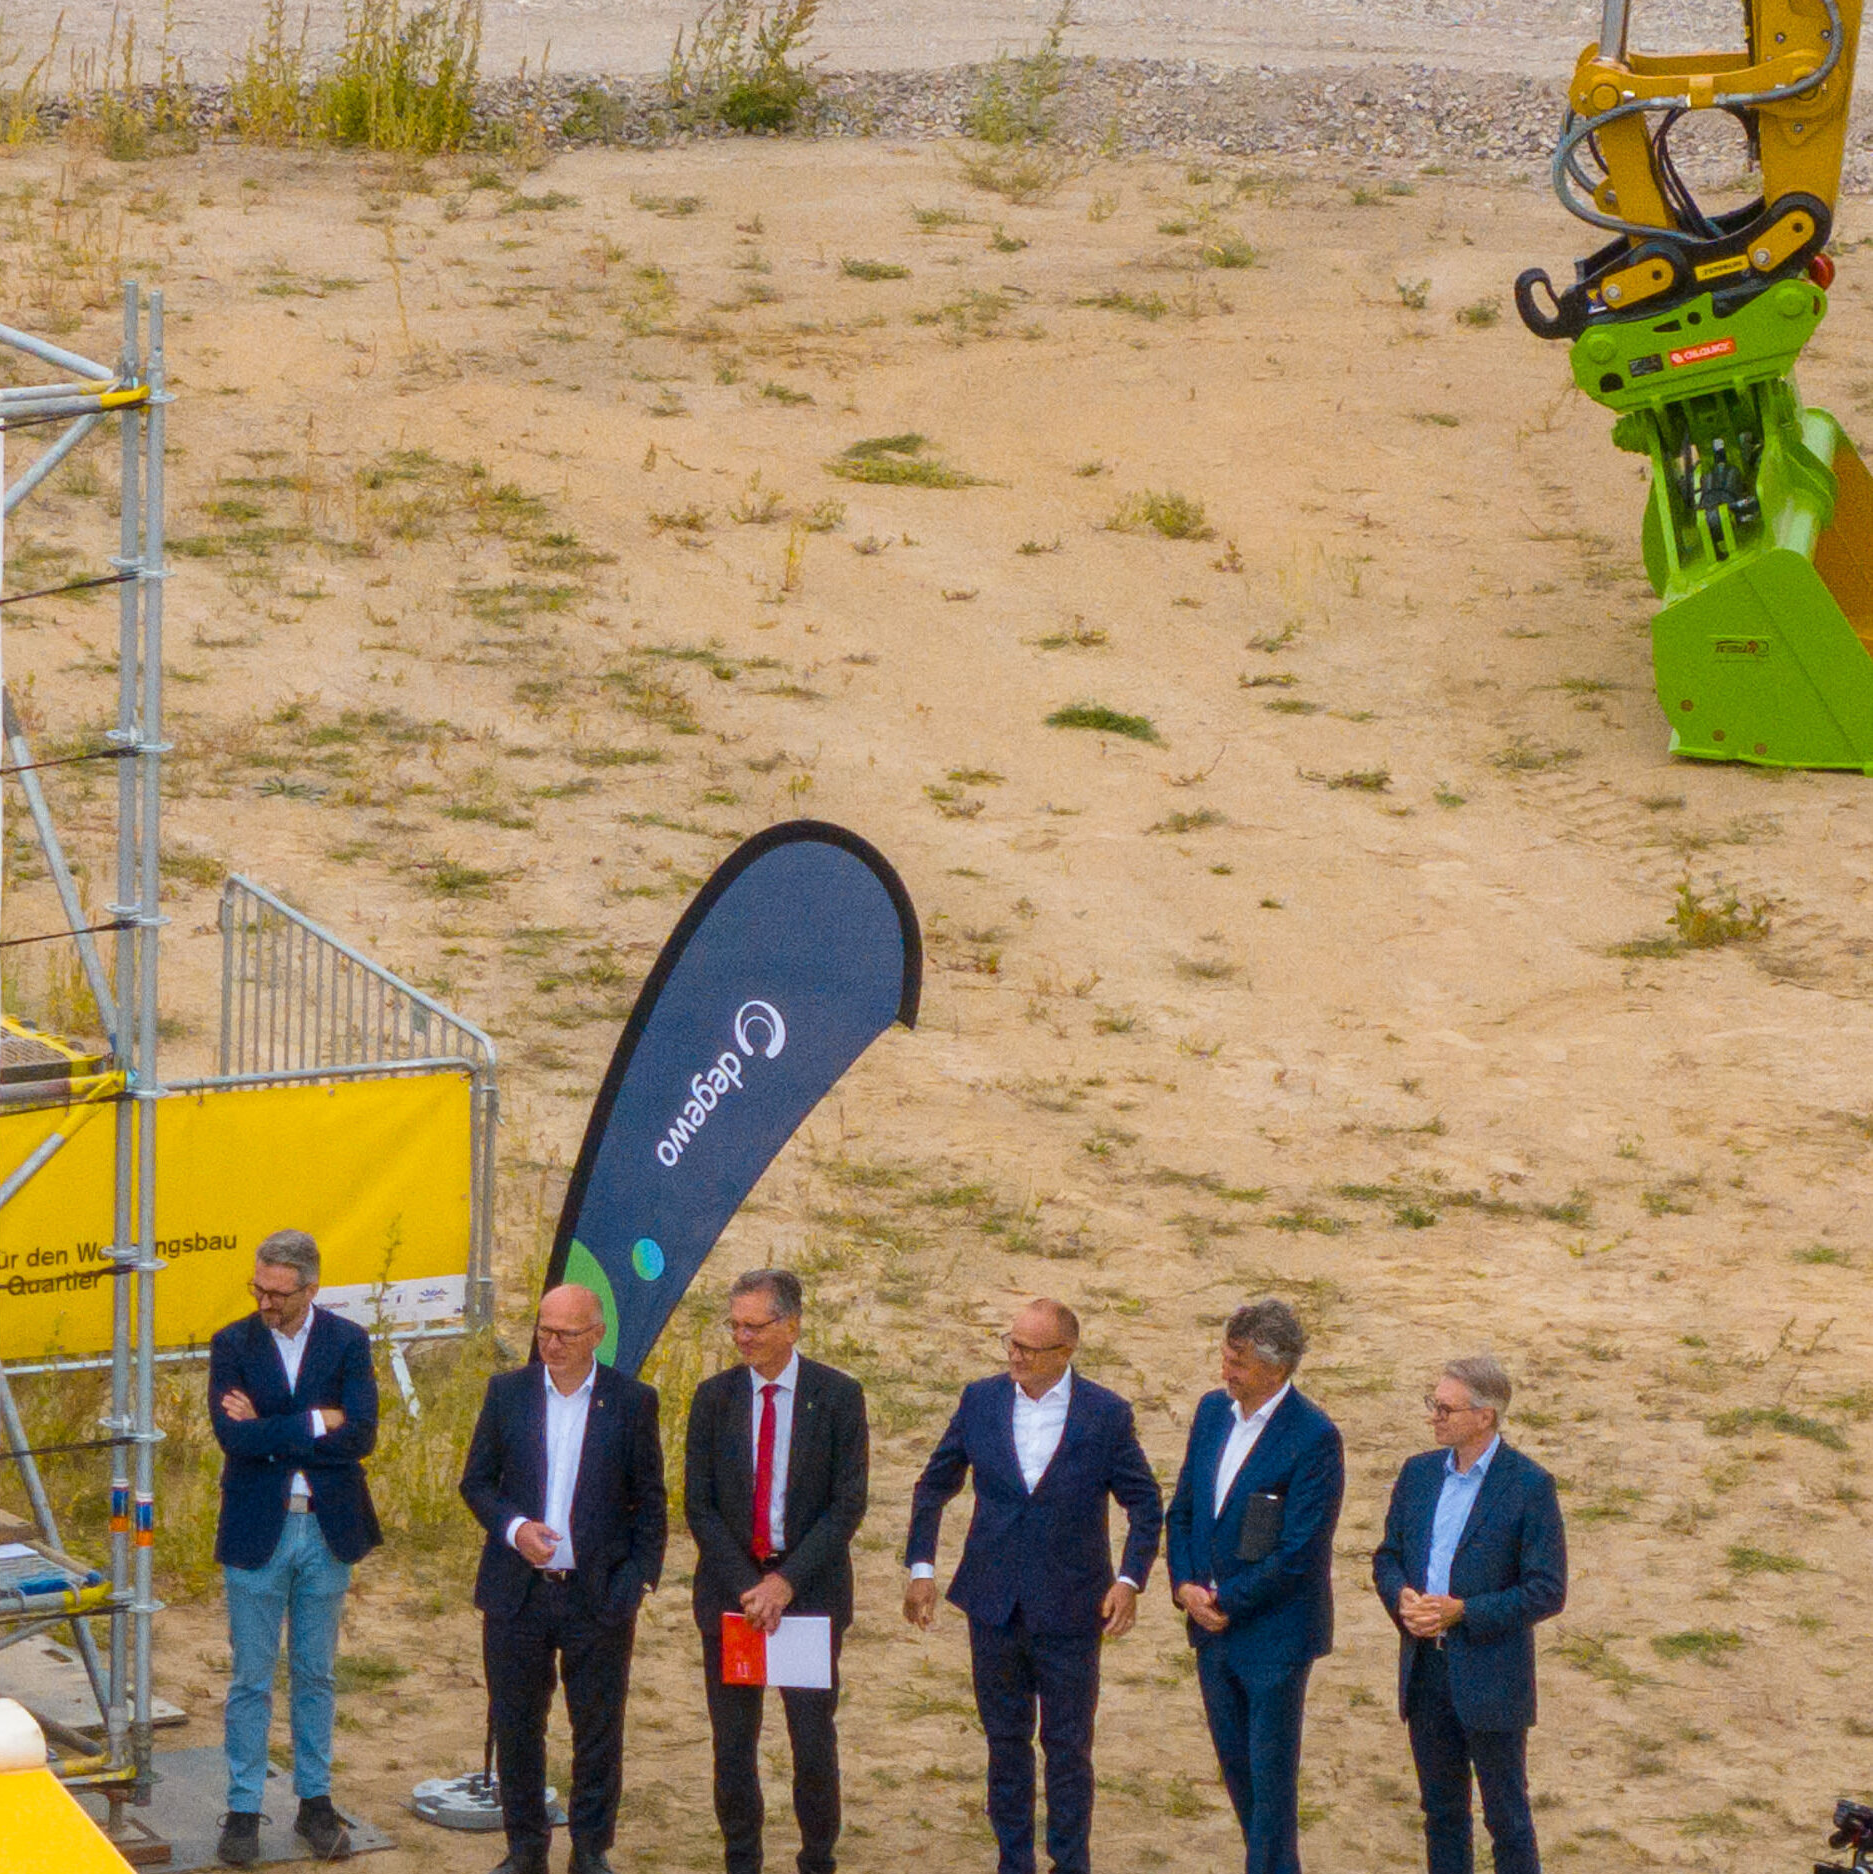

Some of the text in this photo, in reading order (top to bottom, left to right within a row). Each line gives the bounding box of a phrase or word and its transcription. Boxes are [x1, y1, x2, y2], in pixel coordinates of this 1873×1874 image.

[657, 1052, 744, 1167] degewo
[27, 1247, 68, 1267] den
[8, 1271, 100, 1296] Quartier
